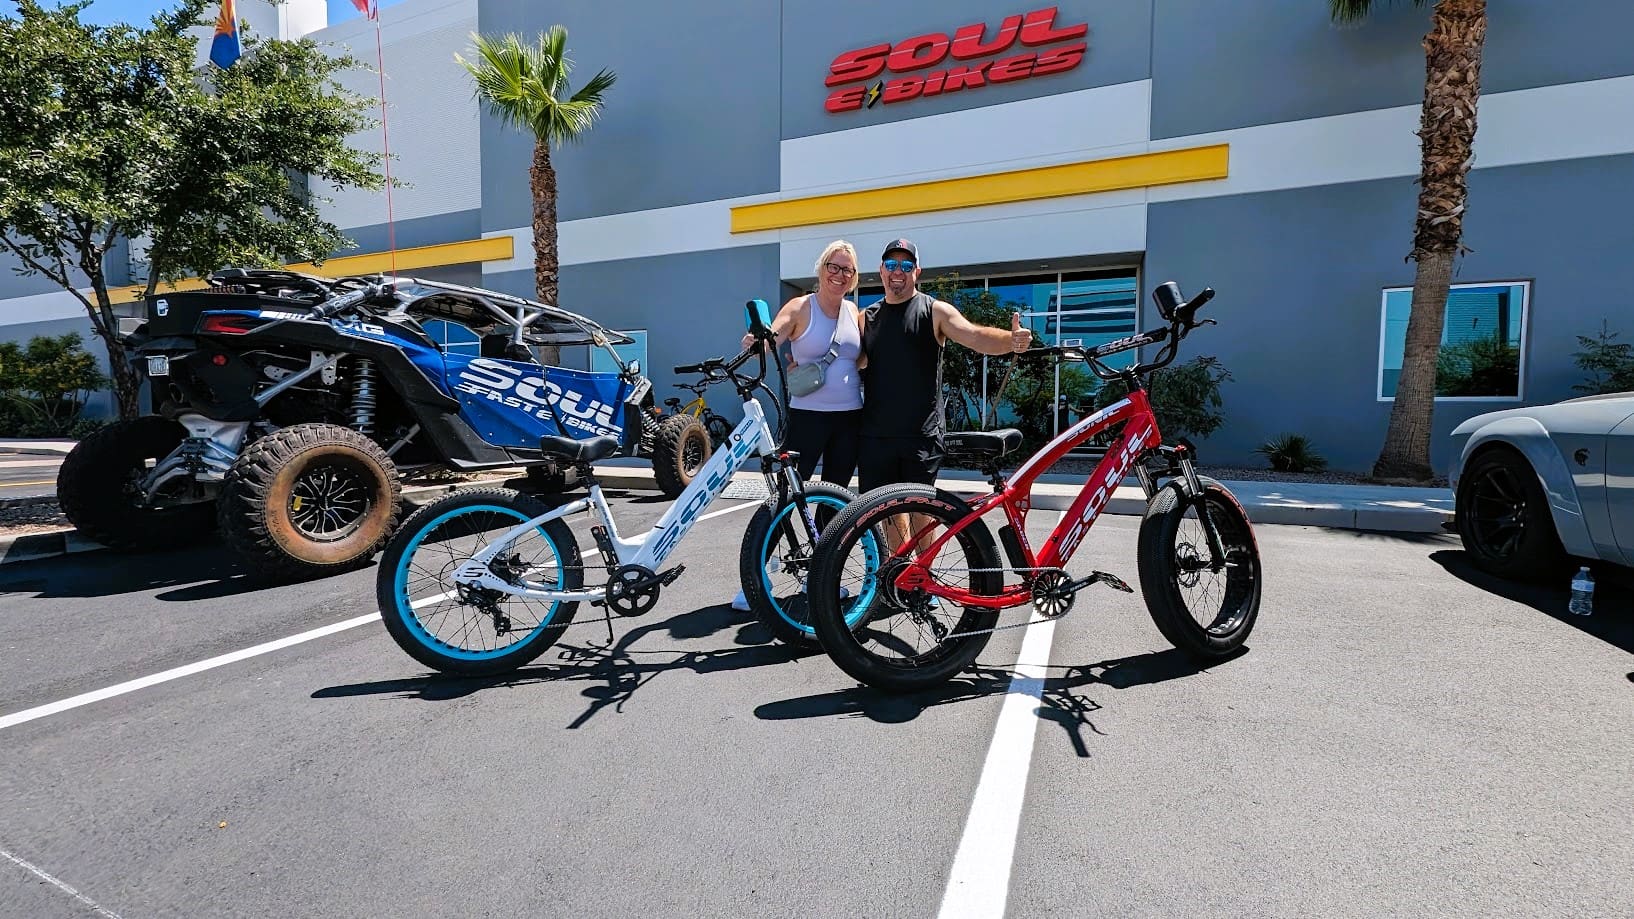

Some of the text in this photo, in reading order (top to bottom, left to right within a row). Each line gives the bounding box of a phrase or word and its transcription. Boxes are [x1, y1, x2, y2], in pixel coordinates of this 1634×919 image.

[824, 42, 1087, 113] E BIKES
[825, 6, 1088, 87] SOUL
[454, 382, 539, 413] FAST
[535, 409, 553, 420] E
[459, 358, 623, 432] SOUL
[652, 430, 761, 562] SOUL
[855, 498, 903, 529] SOUL
[1058, 423, 1152, 562] SOUL
